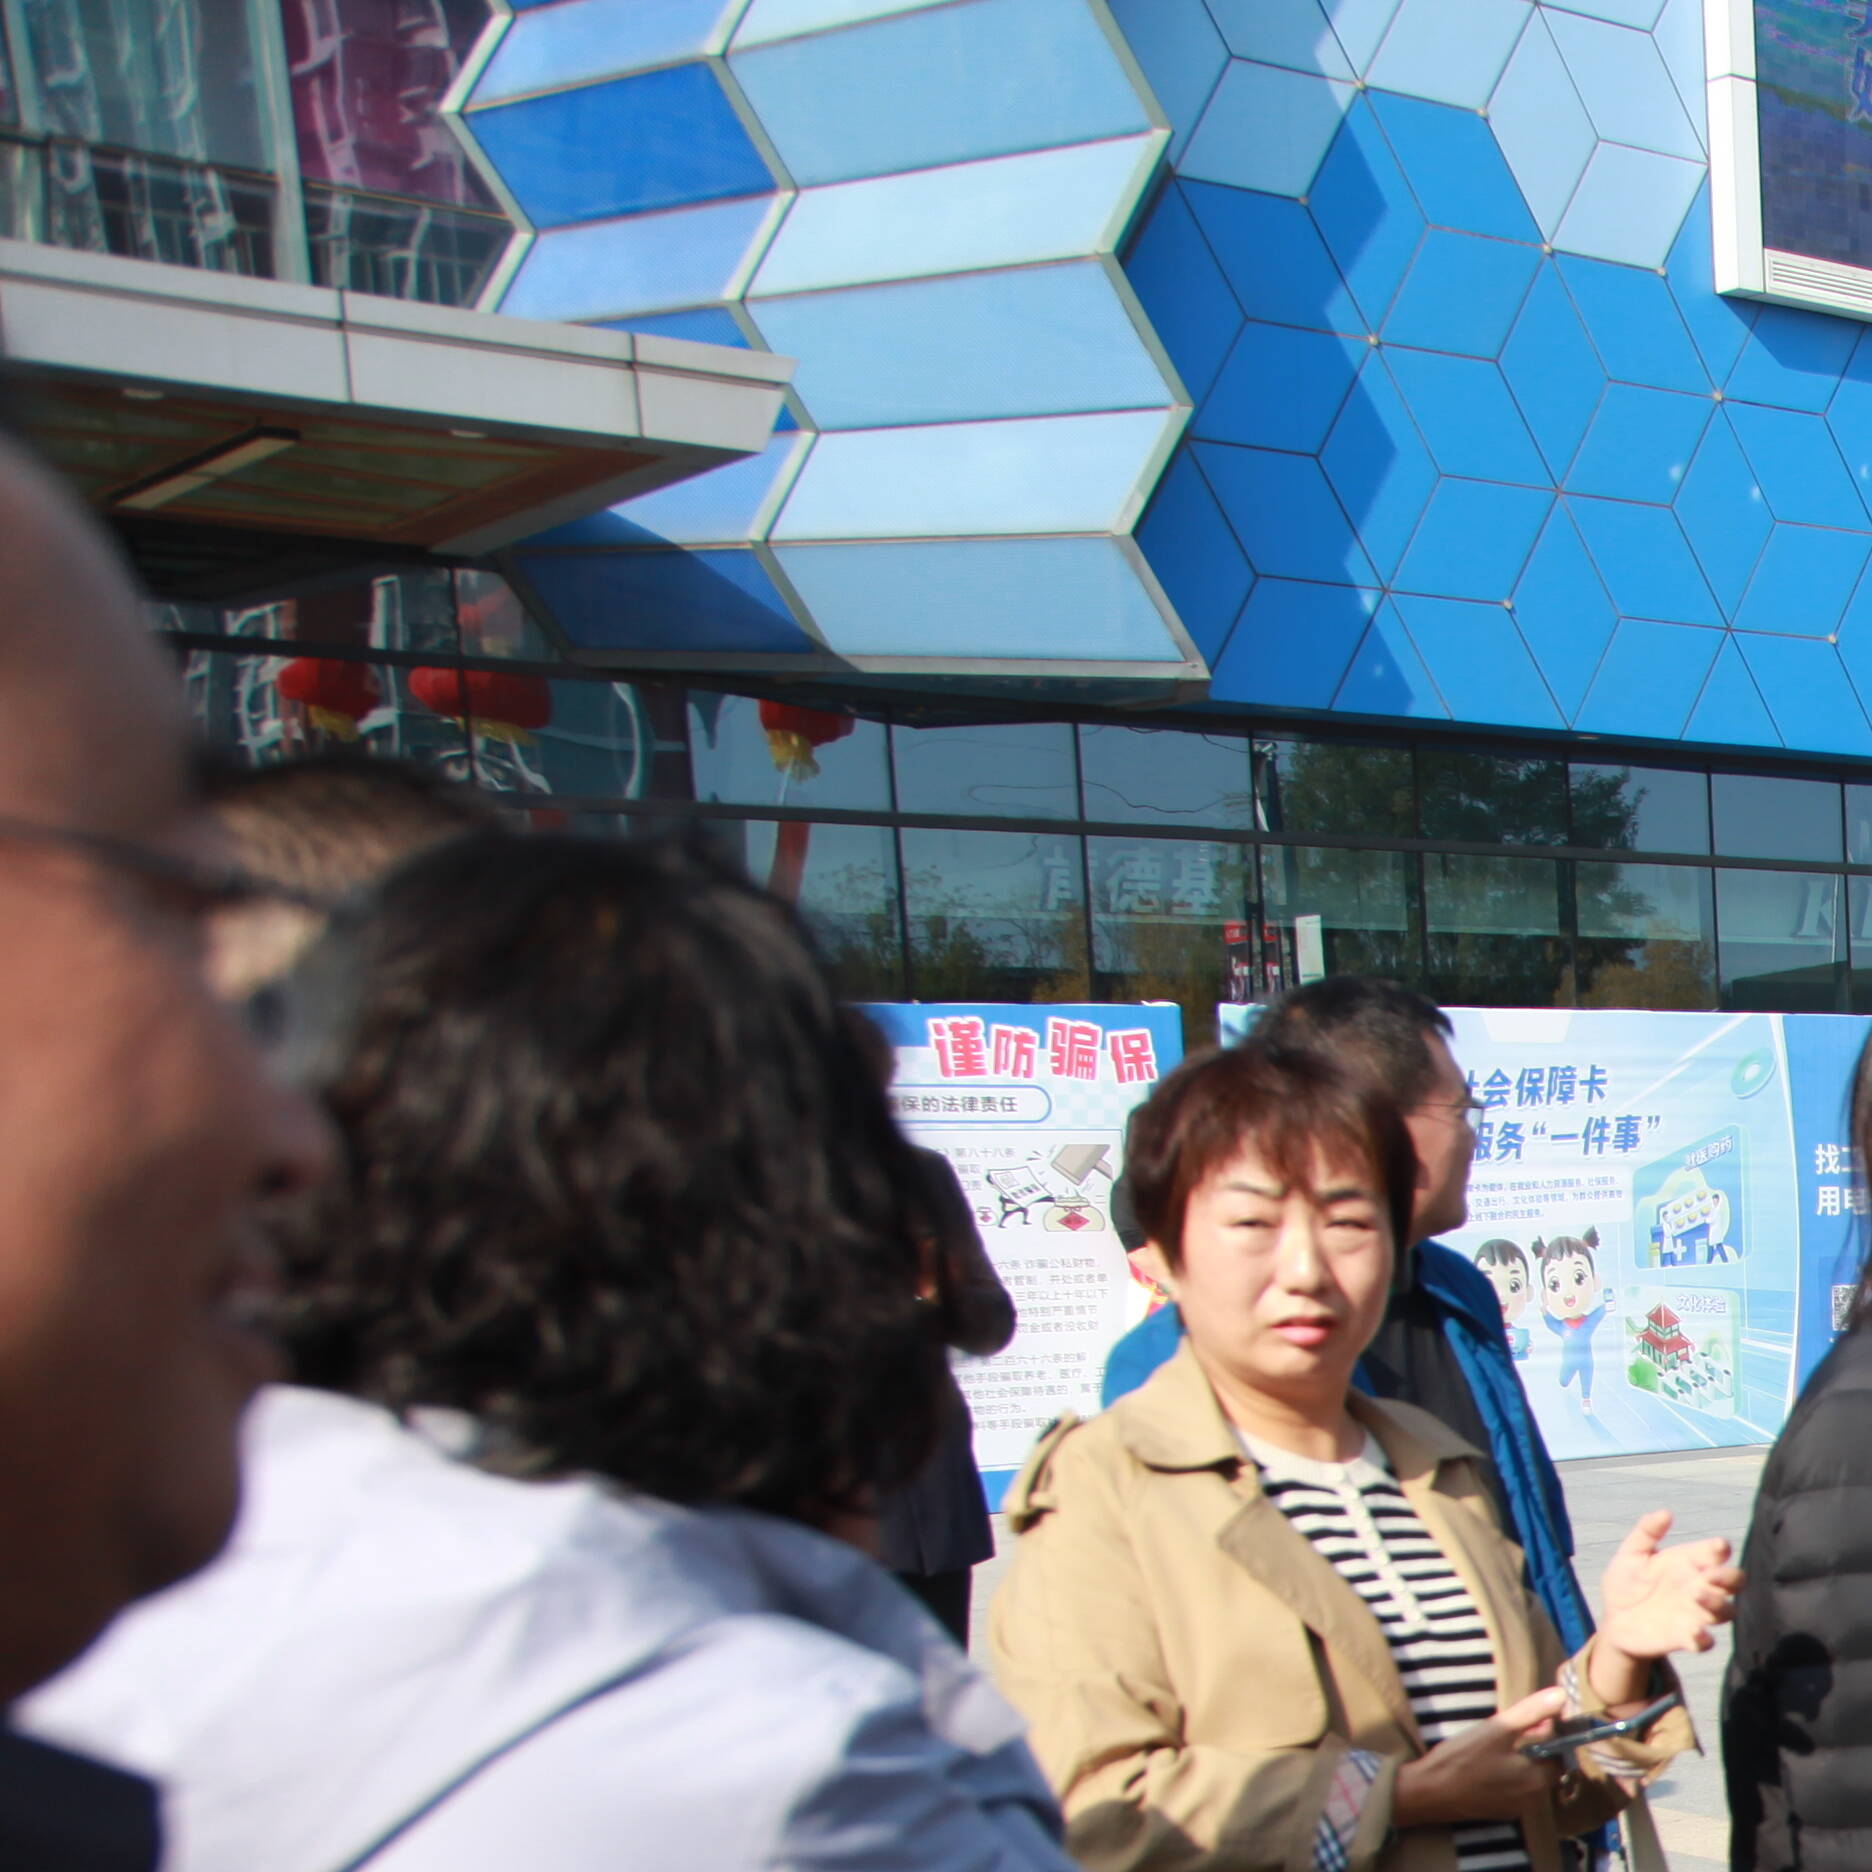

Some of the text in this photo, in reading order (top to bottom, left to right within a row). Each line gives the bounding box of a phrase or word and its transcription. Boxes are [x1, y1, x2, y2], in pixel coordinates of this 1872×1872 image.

[931, 1019, 1157, 1083] 谨防骗保
[889, 1095, 1018, 1113] 保的法律责任
